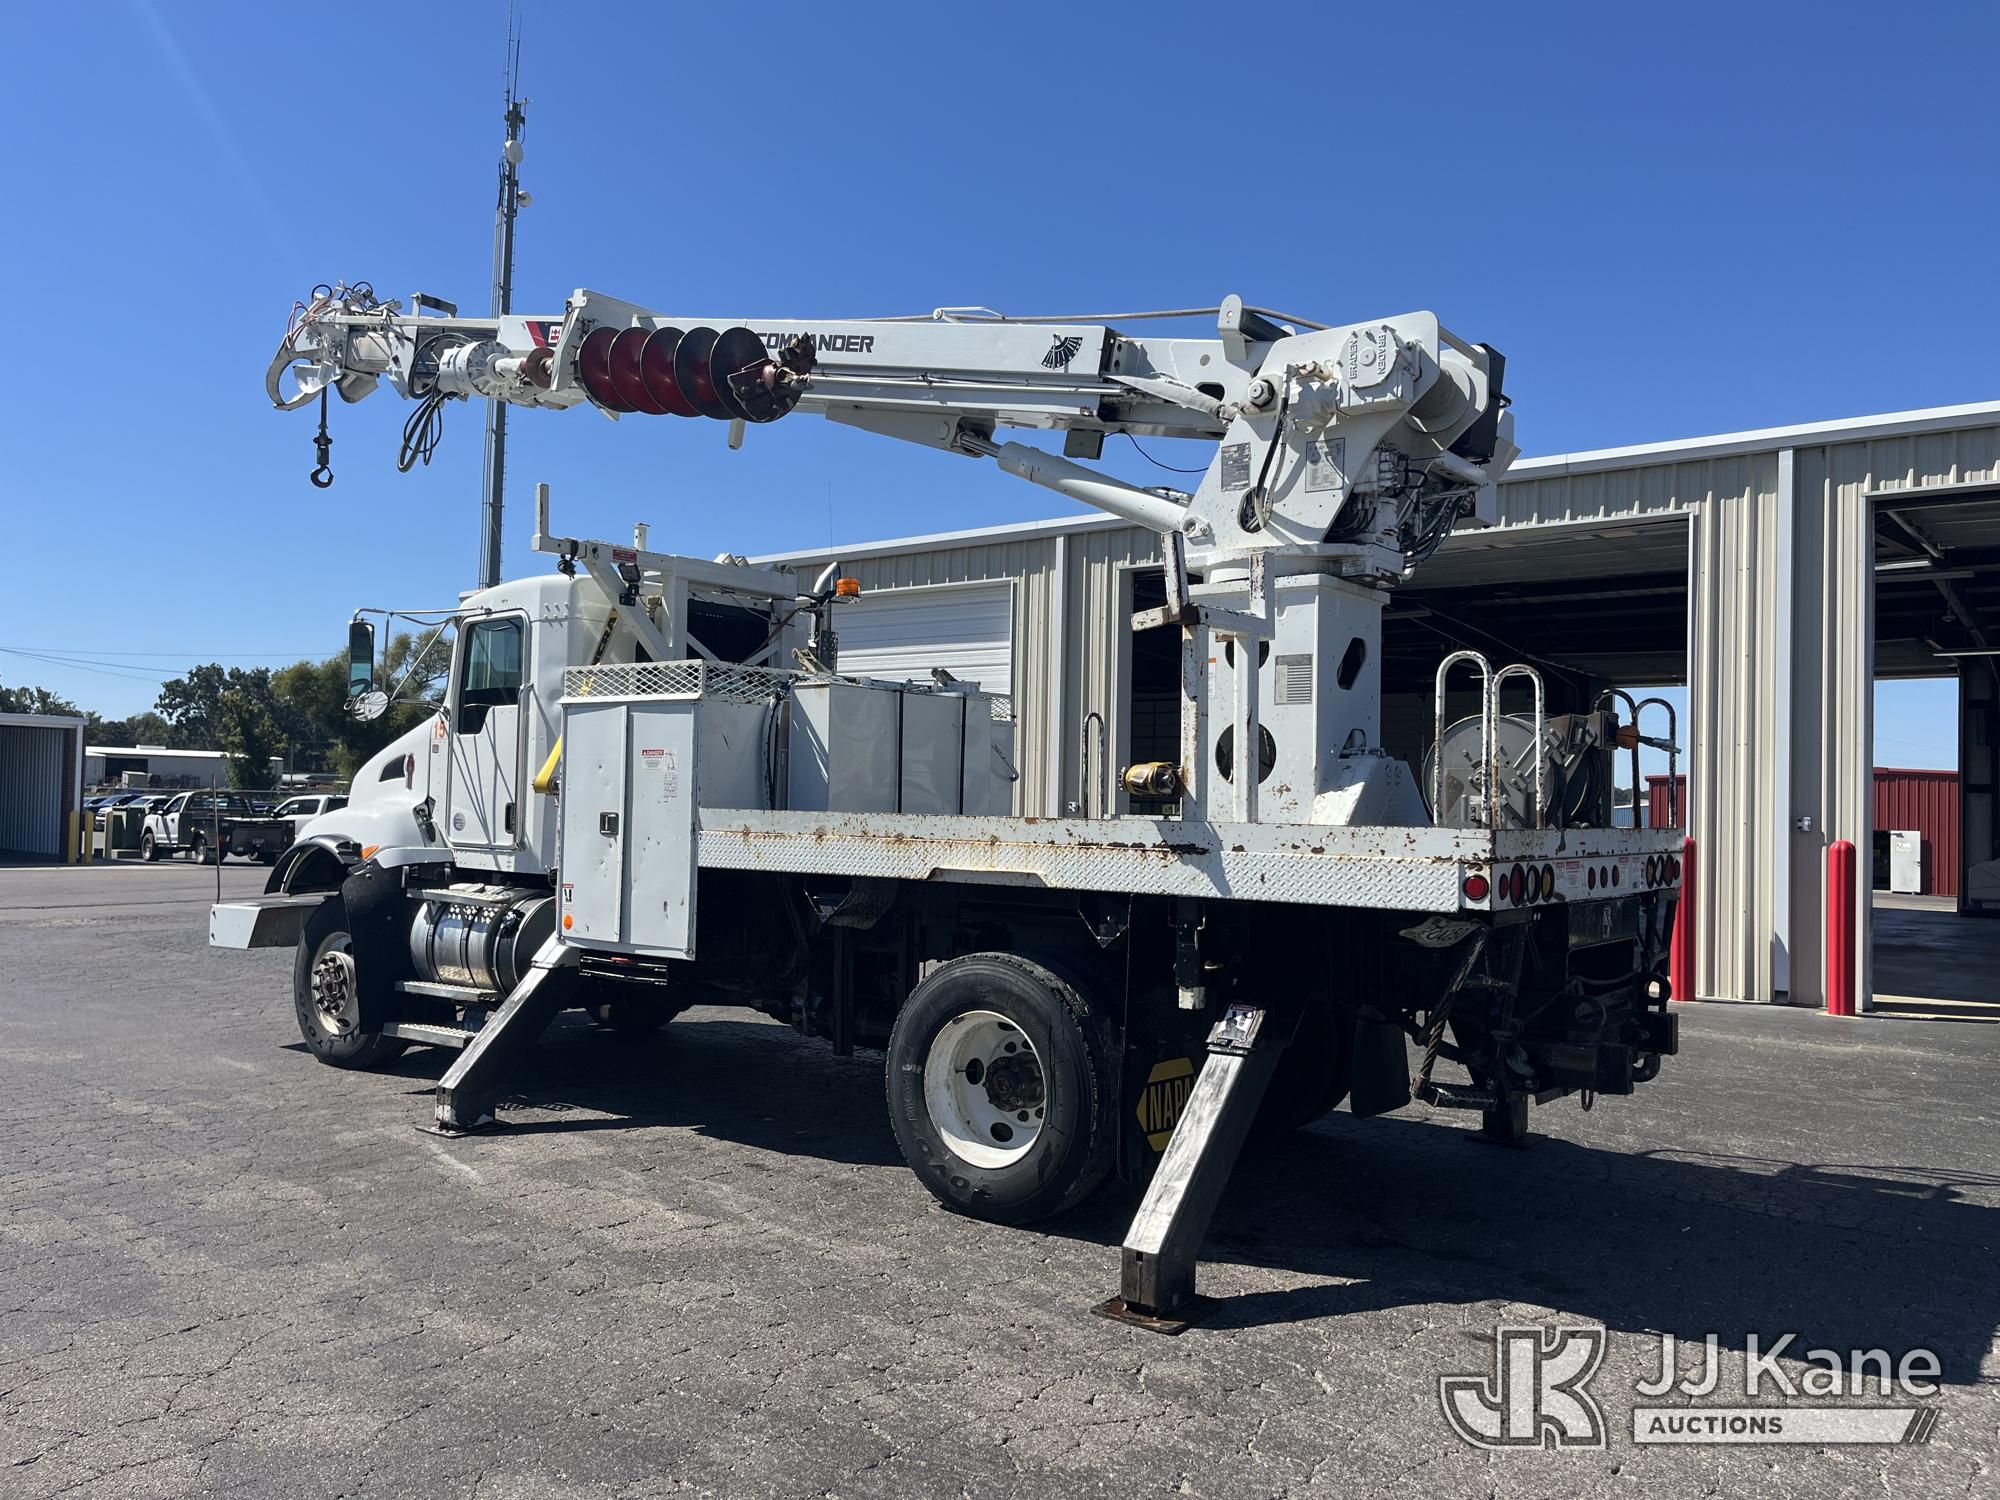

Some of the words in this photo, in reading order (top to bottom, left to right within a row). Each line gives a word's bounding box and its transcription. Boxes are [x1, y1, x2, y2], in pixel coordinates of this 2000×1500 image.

[756, 332, 875, 353] OMNDER
[1349, 340, 1358, 380] BRADEN
[1377, 334, 1387, 375] BRADEN
